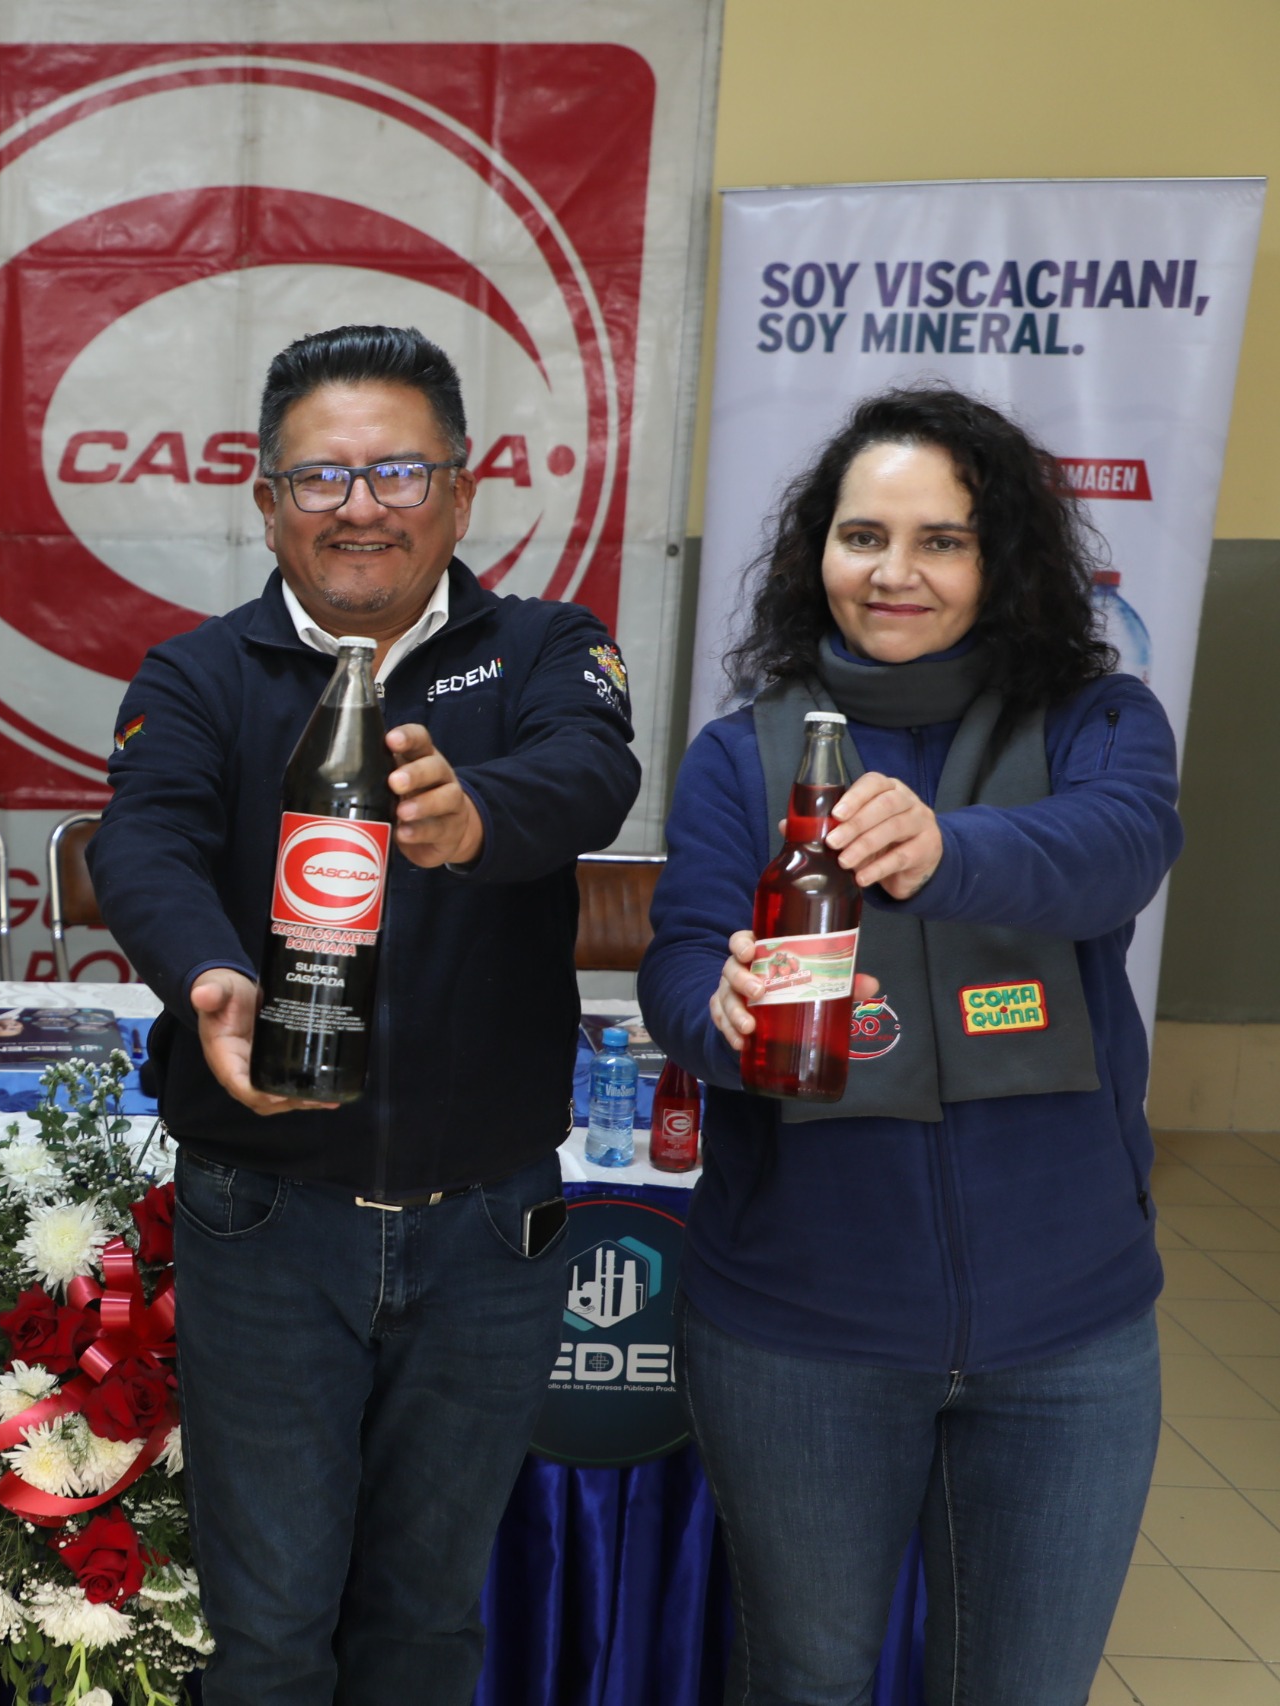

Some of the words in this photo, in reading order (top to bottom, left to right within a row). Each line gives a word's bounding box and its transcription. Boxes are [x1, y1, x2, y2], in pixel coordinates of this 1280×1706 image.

[760, 261, 861, 308] SOY
[875, 259, 1211, 317] VISCACHANI,
[756, 312, 848, 354] SOY
[860, 312, 1085, 356] MINERAL.
[271, 921, 378, 946] ORGULLOSAMENTE
[285, 936, 357, 957] BOLIVIANA
[295, 962, 338, 975] SUPER
[286, 972, 345, 988] CASCADA
[969, 986, 1037, 1009] COKA
[585, 1383, 622, 1391] Empresas
[623, 1384, 654, 1392] Públicas
